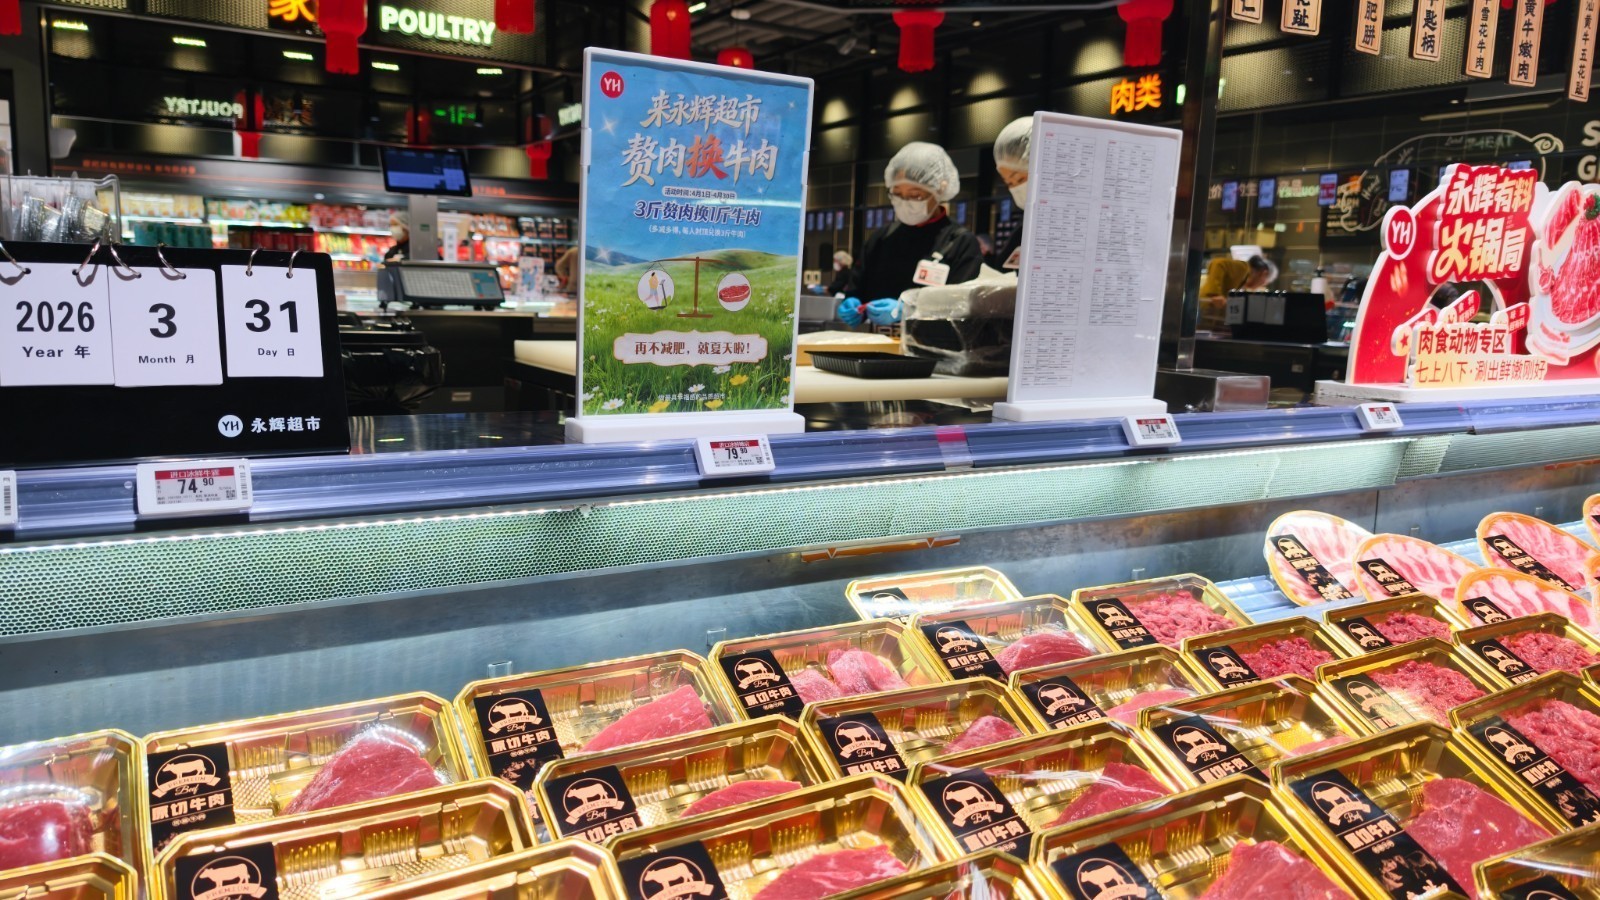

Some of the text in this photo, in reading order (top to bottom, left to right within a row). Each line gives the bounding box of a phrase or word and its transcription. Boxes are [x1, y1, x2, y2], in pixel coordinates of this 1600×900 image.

[380, 5, 496, 45] POULTRY
[1421, 0, 1437, 54] 匙柄
[1475, 0, 1491, 70] 雪花牛肉
[603, 77, 621, 92] YH
[1110, 75, 1162, 115] 肉类
[640, 89, 762, 136] 来永辉超市
[620, 132, 779, 186] 赘肉换牛肉
[1446, 172, 1534, 215] 永辉有料
[634, 200, 762, 227] 3斤赘肉换1斤牛肉
[1391, 221, 1411, 245] YH
[1434, 217, 1527, 278] 火锅局
[16, 300, 95, 332] 2026
[148, 303, 178, 338] 3
[245, 299, 299, 333] 31
[22, 344, 91, 359] Year 年
[257, 347, 295, 357] Day 日
[1418, 327, 1507, 354] 肉食动物专区
[138, 354, 195, 364] Month 月
[221, 415, 321, 434] YH 永辉超市
[491, 730, 551, 753] 原切牛肉
[168, 776, 207, 789] PREMIUM
[174, 783, 200, 796] Beef
[151, 793, 225, 821] 原切牛肉
[585, 808, 608, 822] Beef
[205, 885, 250, 899] PREMIUM
